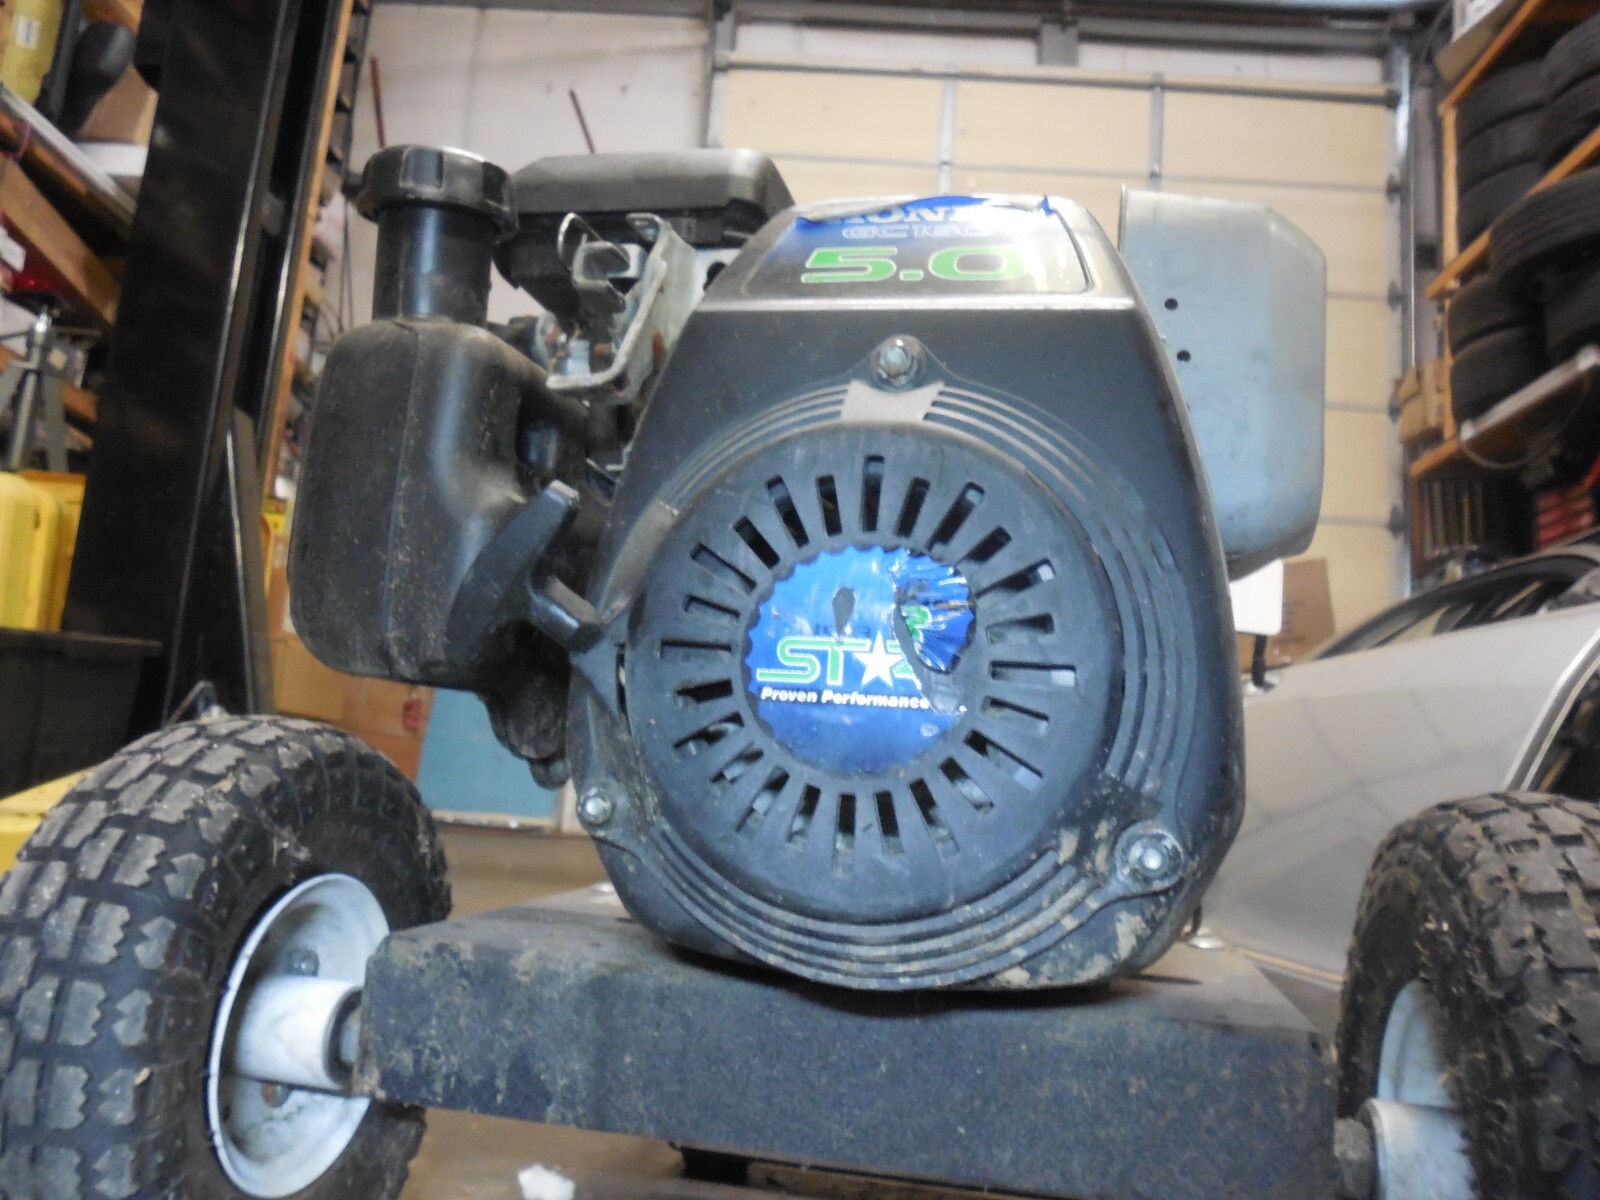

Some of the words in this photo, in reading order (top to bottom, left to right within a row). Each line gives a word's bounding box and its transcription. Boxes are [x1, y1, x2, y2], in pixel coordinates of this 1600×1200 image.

[801, 246, 1024, 283] 5.0
[761, 687, 817, 703] Proven
[821, 690, 930, 709] Performance
